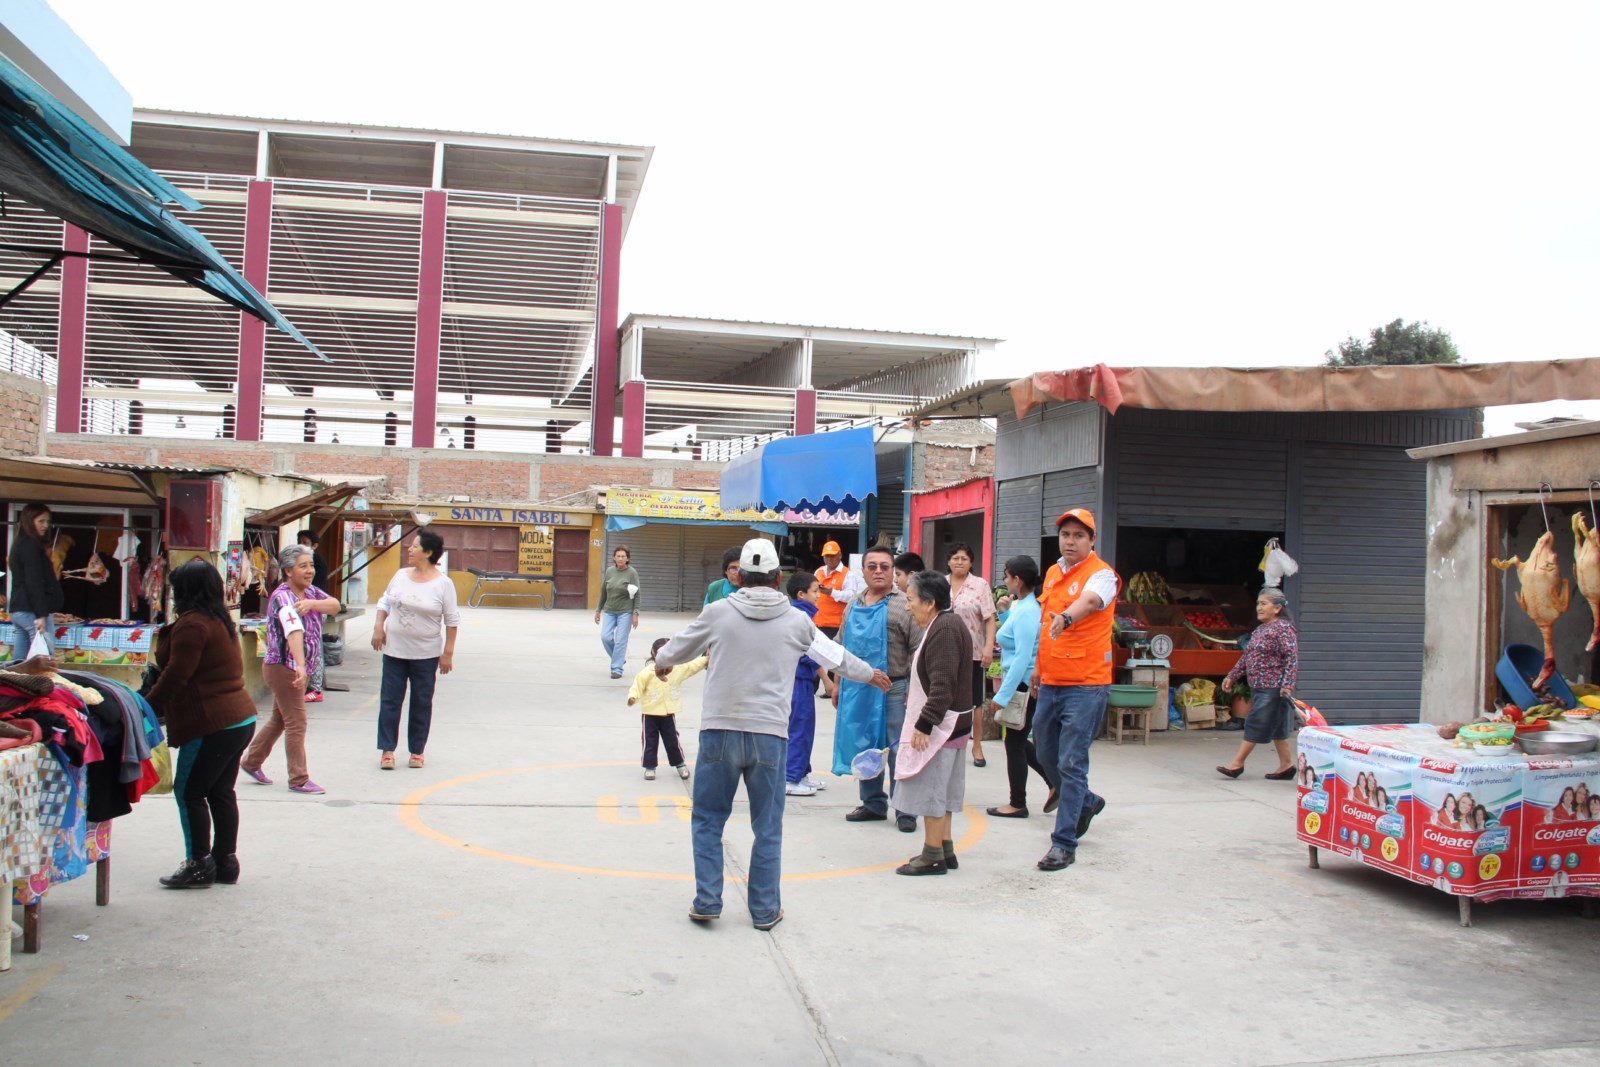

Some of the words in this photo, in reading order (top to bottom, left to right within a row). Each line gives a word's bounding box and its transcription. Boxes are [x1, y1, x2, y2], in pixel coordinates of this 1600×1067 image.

[451, 508, 503, 522] SANTA
[512, 511, 570, 525] ISABEL
[1342, 739, 1370, 752] Colgate
[1342, 804, 1377, 823] Colgate
[1423, 828, 1474, 849] Colgate
[1534, 827, 1588, 842] Colgate
[1535, 855, 1541, 866] 1
[1552, 856, 1559, 865] 2
[1568, 853, 1576, 863] 3
[1450, 862, 1460, 873] 3
